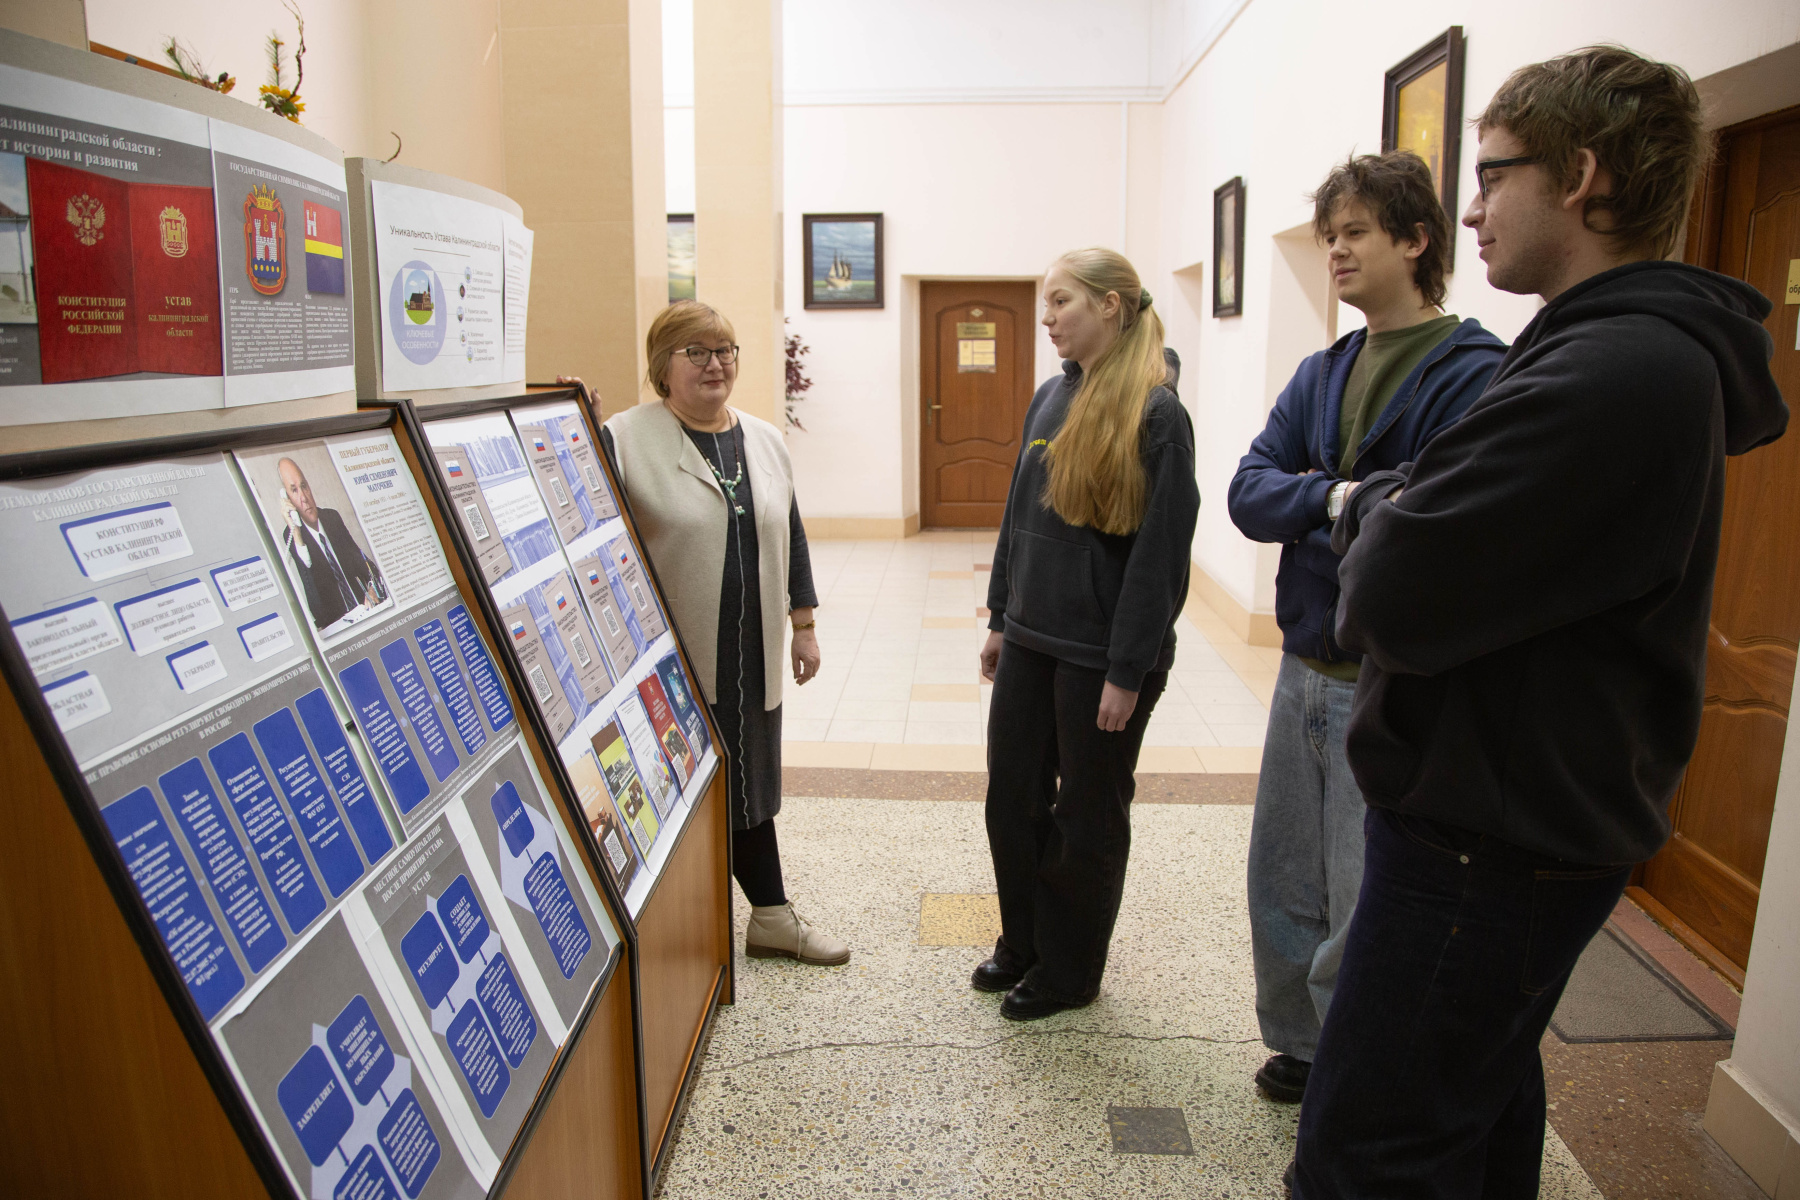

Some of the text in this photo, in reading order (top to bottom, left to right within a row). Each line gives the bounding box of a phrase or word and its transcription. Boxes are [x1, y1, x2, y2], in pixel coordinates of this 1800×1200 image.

[1, 118, 110, 147] алининградской
[112, 137, 156, 156] области
[14, 140, 139, 172] истории и развития
[390, 224, 434, 241] Уникальность
[434, 231, 451, 244] Устава
[452, 234, 487, 250] Калининградской
[58, 295, 127, 308] КОНСТИТУЦИЯ
[62, 309, 125, 321] РОССИЙСКОЙ
[67, 324, 122, 335] ФЕДЕРАЦИИ
[166, 327, 194, 337] области
[406, 329, 434, 339] КЛЮЧЕВЫЕ
[402, 341, 439, 350] ОСОБЕННОСТИ
[339, 443, 389, 459] ПЕРВЫЙ ГУБЕРНАТОР
[344, 459, 381, 472] Калининградской
[32, 487, 86, 506] ОРГАНОВ
[87, 469, 177, 498] ГОСУДАРСТВЕННОЙ
[177, 466, 206, 483] ВЛАСТИ
[353, 468, 398, 485] ЮРИЙ СЕМЕНОВИЧ
[367, 480, 393, 492] МАТОЧКИН
[33, 484, 179, 522] КАЛИНИНГРАДСКОЙ ОБЛАСТИ
[96, 517, 165, 540] КОНСТИТУЦИЯ РФ
[83, 528, 183, 561] УСТАВ КАЛИНИНГРАДСКОЙ
[128, 546, 160, 562] ОБЛАСТИ
[45, 616, 68, 629] высший
[131, 606, 186, 631] ДОЛЖНОСТНОЕ ЛИЦО
[154, 613, 195, 633] руководит работой
[163, 625, 196, 642] правительства
[251, 630, 286, 649] ПРАВИТЕЛЬСТВО
[184, 659, 216, 678] ГУБЕРНАТОР
[67, 703, 88, 717] ДУМА
[98, 748, 141, 779] ПРАВОВЫЕ
[140, 735, 172, 756] ОСНОВЫ
[172, 711, 215, 740] РЕГУЛИРУЮТ
[215, 694, 252, 716] СВОБОДНУЮ
[251, 670, 299, 698] ЭКОНОМИЧЕСКУЮ
[278, 754, 306, 774] Регулирование
[324, 746, 345, 762] Управление
[231, 781, 247, 794] сфере
[248, 816, 274, 836] Президента
[260, 834, 293, 861] Правительства
[373, 824, 441, 894] МЕСТНОЕ САМОУПРАВЛЕНИЕ
[381, 838, 444, 903] ПОСЛЕ ПРИНЯТИЯ УСТАВА
[412, 871, 431, 895] УСТАВ
[450, 896, 466, 918] СОЗДАЕТ
[459, 915, 474, 935] МЕСТНОГО
[418, 942, 443, 976] РЕГУЛИРУЕТ
[340, 1018, 366, 1051] УЧИТЫВАЕТ
[347, 1028, 369, 1054] МНЕНИЯ
[346, 1031, 377, 1069] МУНИЦИПАЛЬ
[359, 1049, 373, 1065] НЫХ
[354, 1045, 384, 1085] ОБРАЗОВАНИЙ
[297, 1082, 335, 1130] ЗАКРЕПЛЯЕТ
